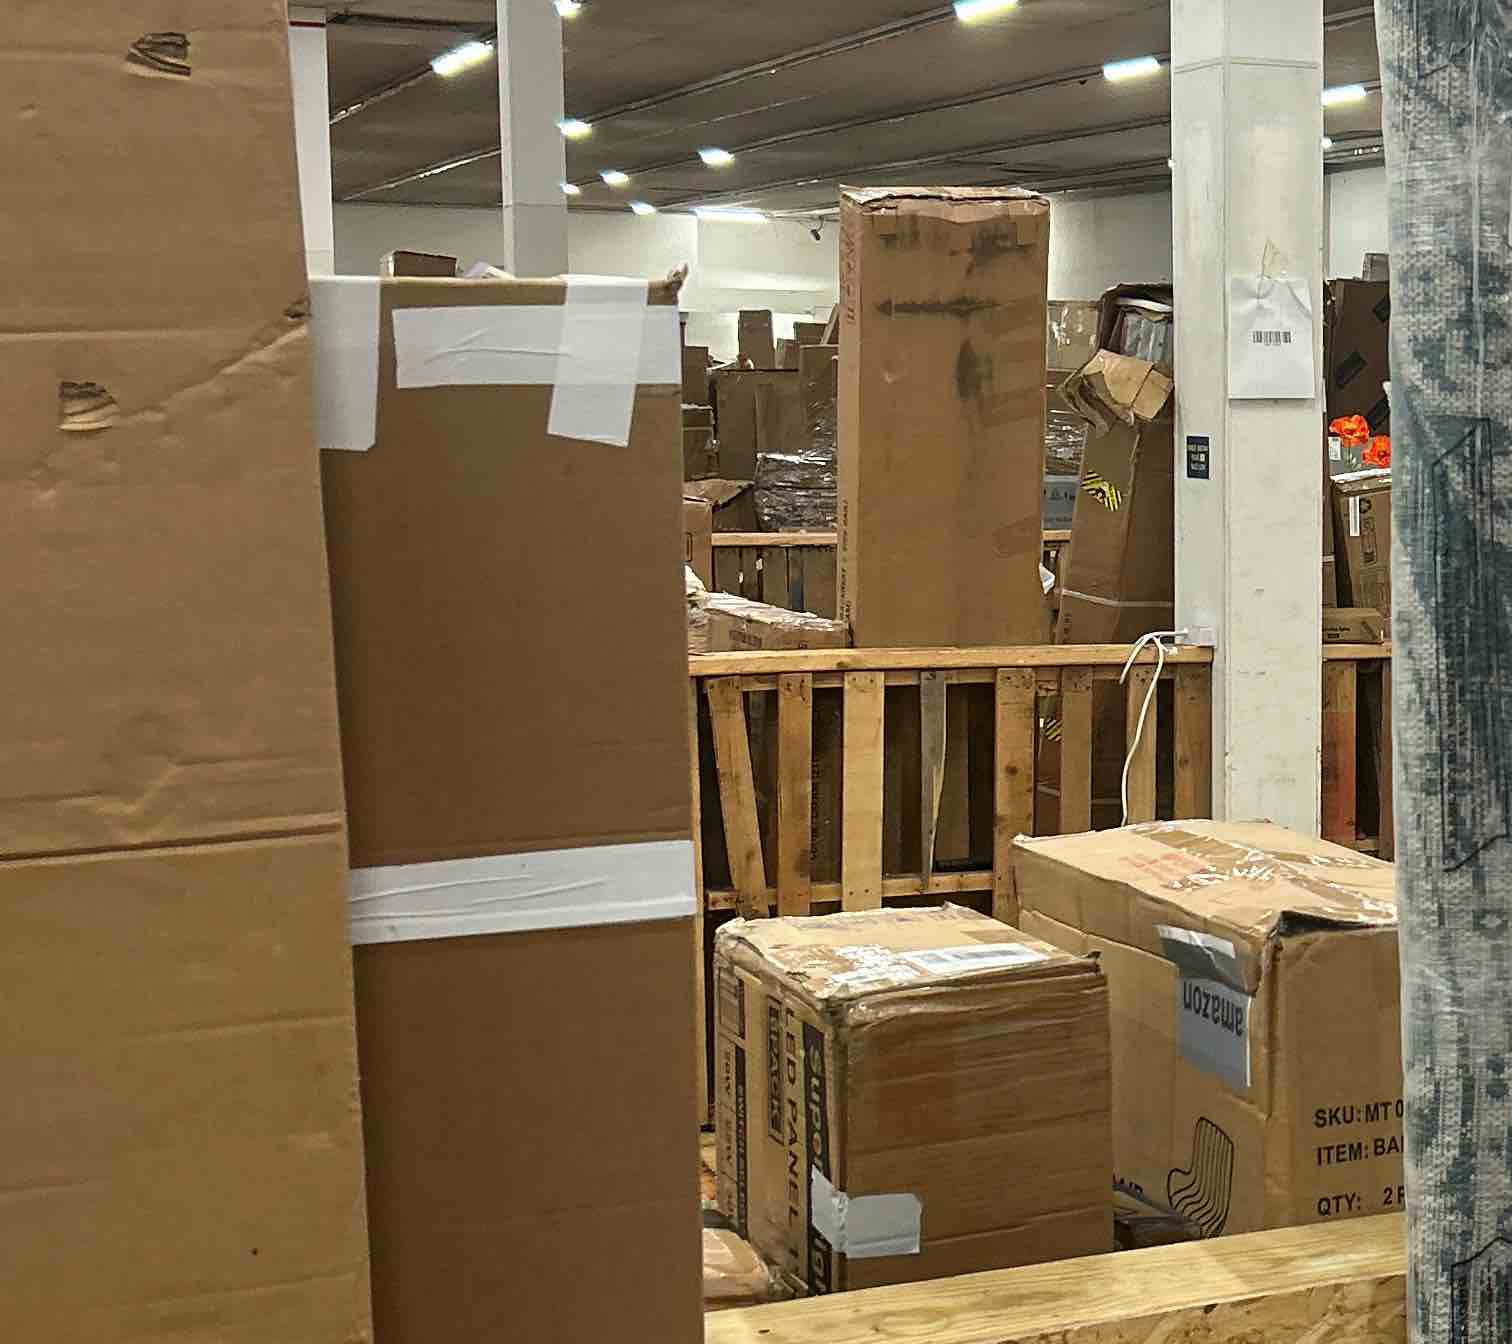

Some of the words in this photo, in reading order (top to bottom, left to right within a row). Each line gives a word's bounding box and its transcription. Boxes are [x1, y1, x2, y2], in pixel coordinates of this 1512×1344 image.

[1183, 981, 1244, 1037] amazon
[784, 1007, 798, 1087] LED
[1314, 1104, 1361, 1128] SKU:
[1366, 1102, 1392, 1122] MT
[785, 1097, 800, 1227] PANEL
[1317, 1142, 1368, 1167] ITEM:
[1317, 1192, 1361, 1216] QTY:
[1384, 1187, 1393, 1205] 2
